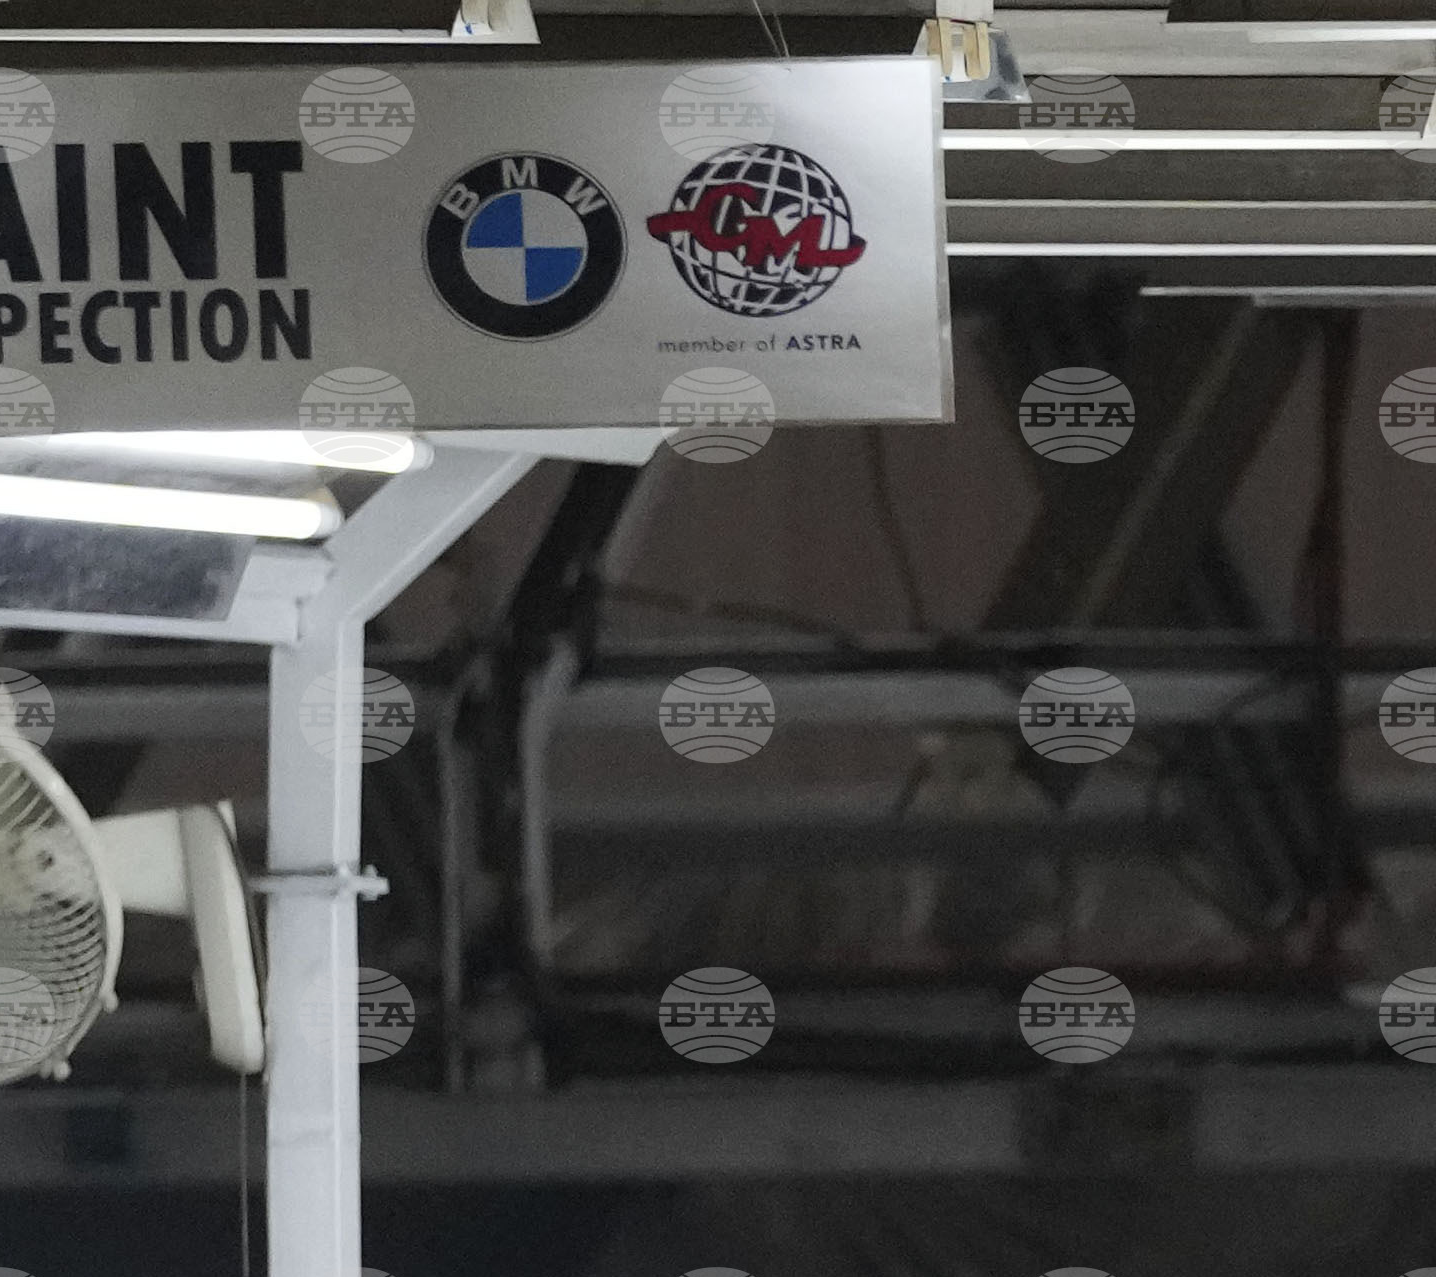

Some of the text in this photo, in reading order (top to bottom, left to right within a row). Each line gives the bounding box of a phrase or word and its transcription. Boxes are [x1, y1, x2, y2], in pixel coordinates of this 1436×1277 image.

[440, 157, 607, 221] BMW
[657, 334, 861, 353] member of ASTRA
